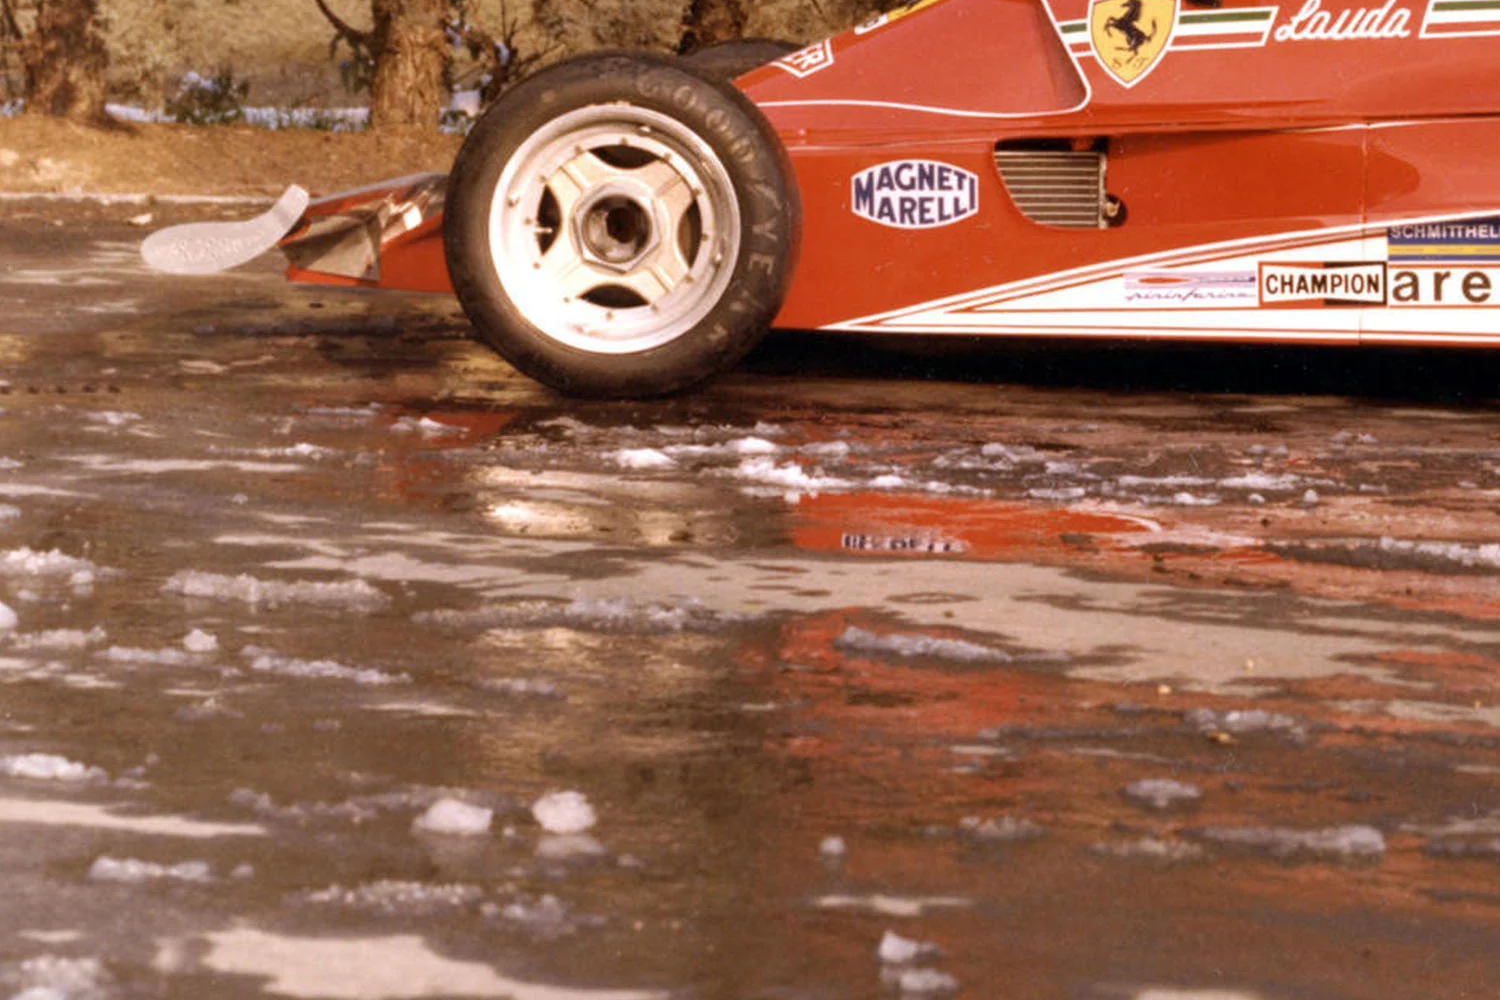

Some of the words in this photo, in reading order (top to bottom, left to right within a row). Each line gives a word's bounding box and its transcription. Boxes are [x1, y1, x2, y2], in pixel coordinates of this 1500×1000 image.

[854, 162, 976, 196] MAGNETI
[854, 192, 976, 225] MARELLI
[1264, 273, 1381, 295] CHAMPION
